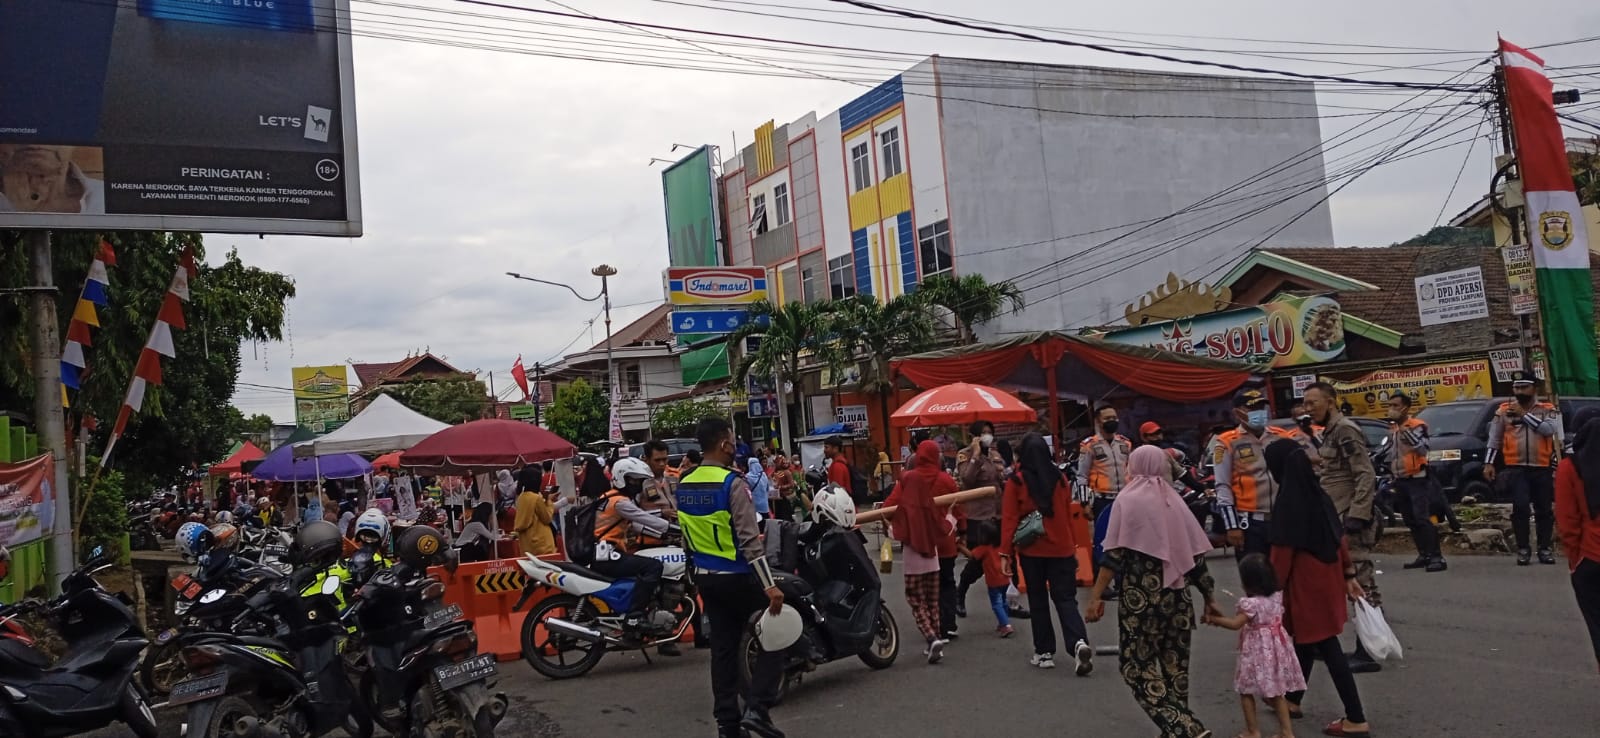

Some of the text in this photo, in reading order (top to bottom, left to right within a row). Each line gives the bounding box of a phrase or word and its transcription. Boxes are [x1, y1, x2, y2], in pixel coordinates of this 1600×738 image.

[259, 115, 302, 127] LET'S
[181, 167, 263, 180] PERINGATAN
[319, 166, 336, 174] 18+
[209, 185, 245, 193] TERKENA
[141, 192, 176, 200] LAYANAN
[178, 193, 216, 201] BERHENTI
[218, 194, 256, 202] MEROKOK
[690, 279, 748, 291] Indomaret
[1437, 286, 1454, 298] DPD
[1455, 281, 1483, 295] APERSI
[1461, 293, 1484, 301] LAMPUNG
[1206, 311, 1294, 358] SOTO
[1424, 366, 1448, 375] PAKAI
[1449, 364, 1486, 373] MASKER
[1442, 374, 1469, 386] 5M
[838, 414, 867, 423] DIJUAL
[680, 495, 714, 505] POLISI
